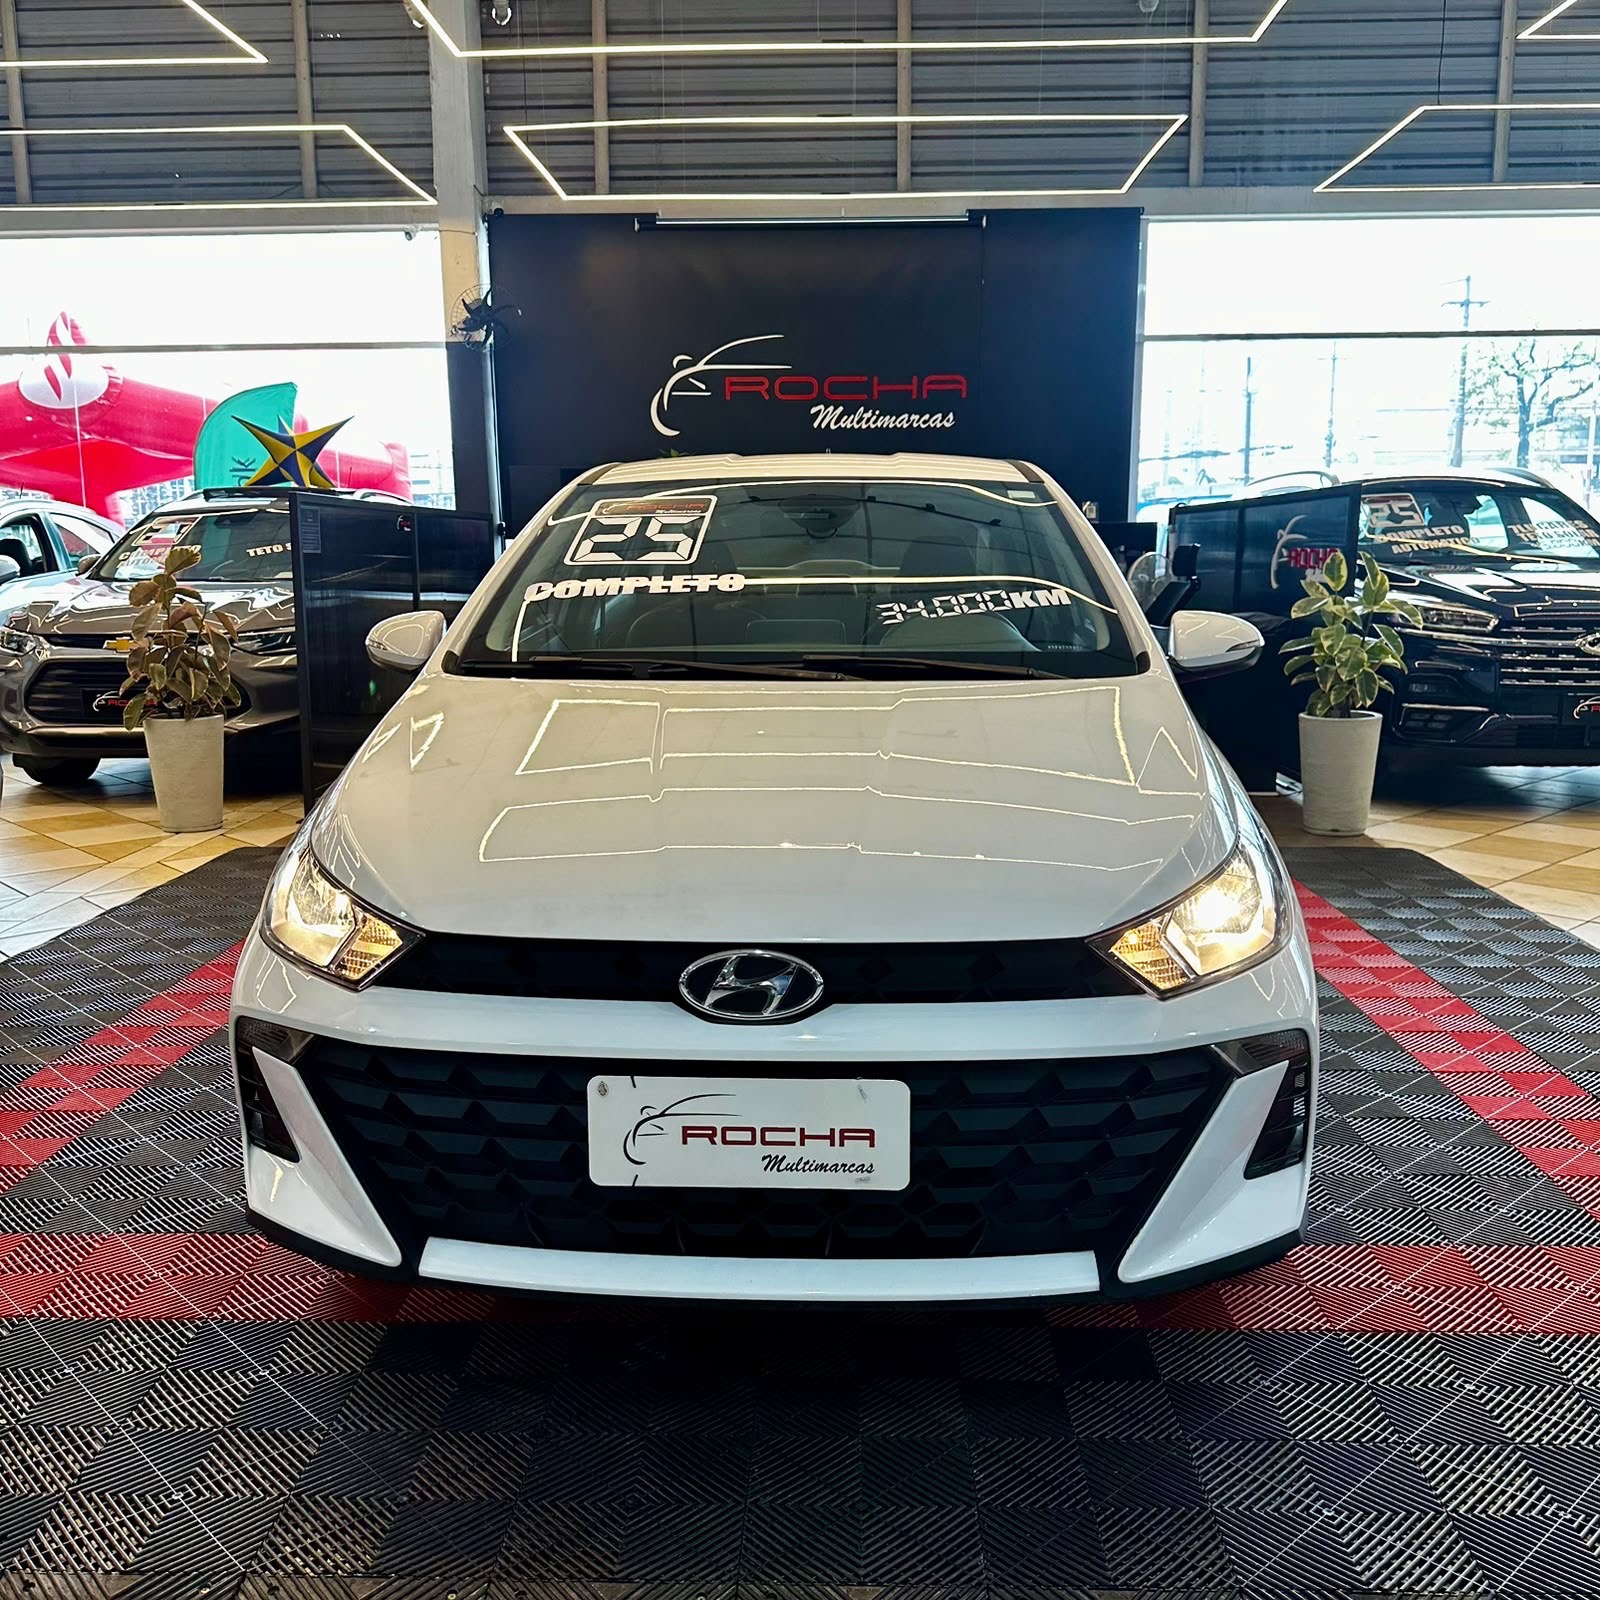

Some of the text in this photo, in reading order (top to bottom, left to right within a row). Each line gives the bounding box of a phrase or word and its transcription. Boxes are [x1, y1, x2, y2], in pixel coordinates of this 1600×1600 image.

[723, 374, 968, 401] ROCHA
[809, 403, 956, 431] Multimarcas
[573, 516, 701, 561] 25
[1374, 524, 1465, 543] COMPLETO
[246, 544, 284, 557] TETO
[524, 573, 746, 602] COMPLETO
[876, 589, 1072, 625] 34.000KM
[681, 1125, 876, 1148] ROCHA
[761, 1153, 875, 1175] Multimarcas
